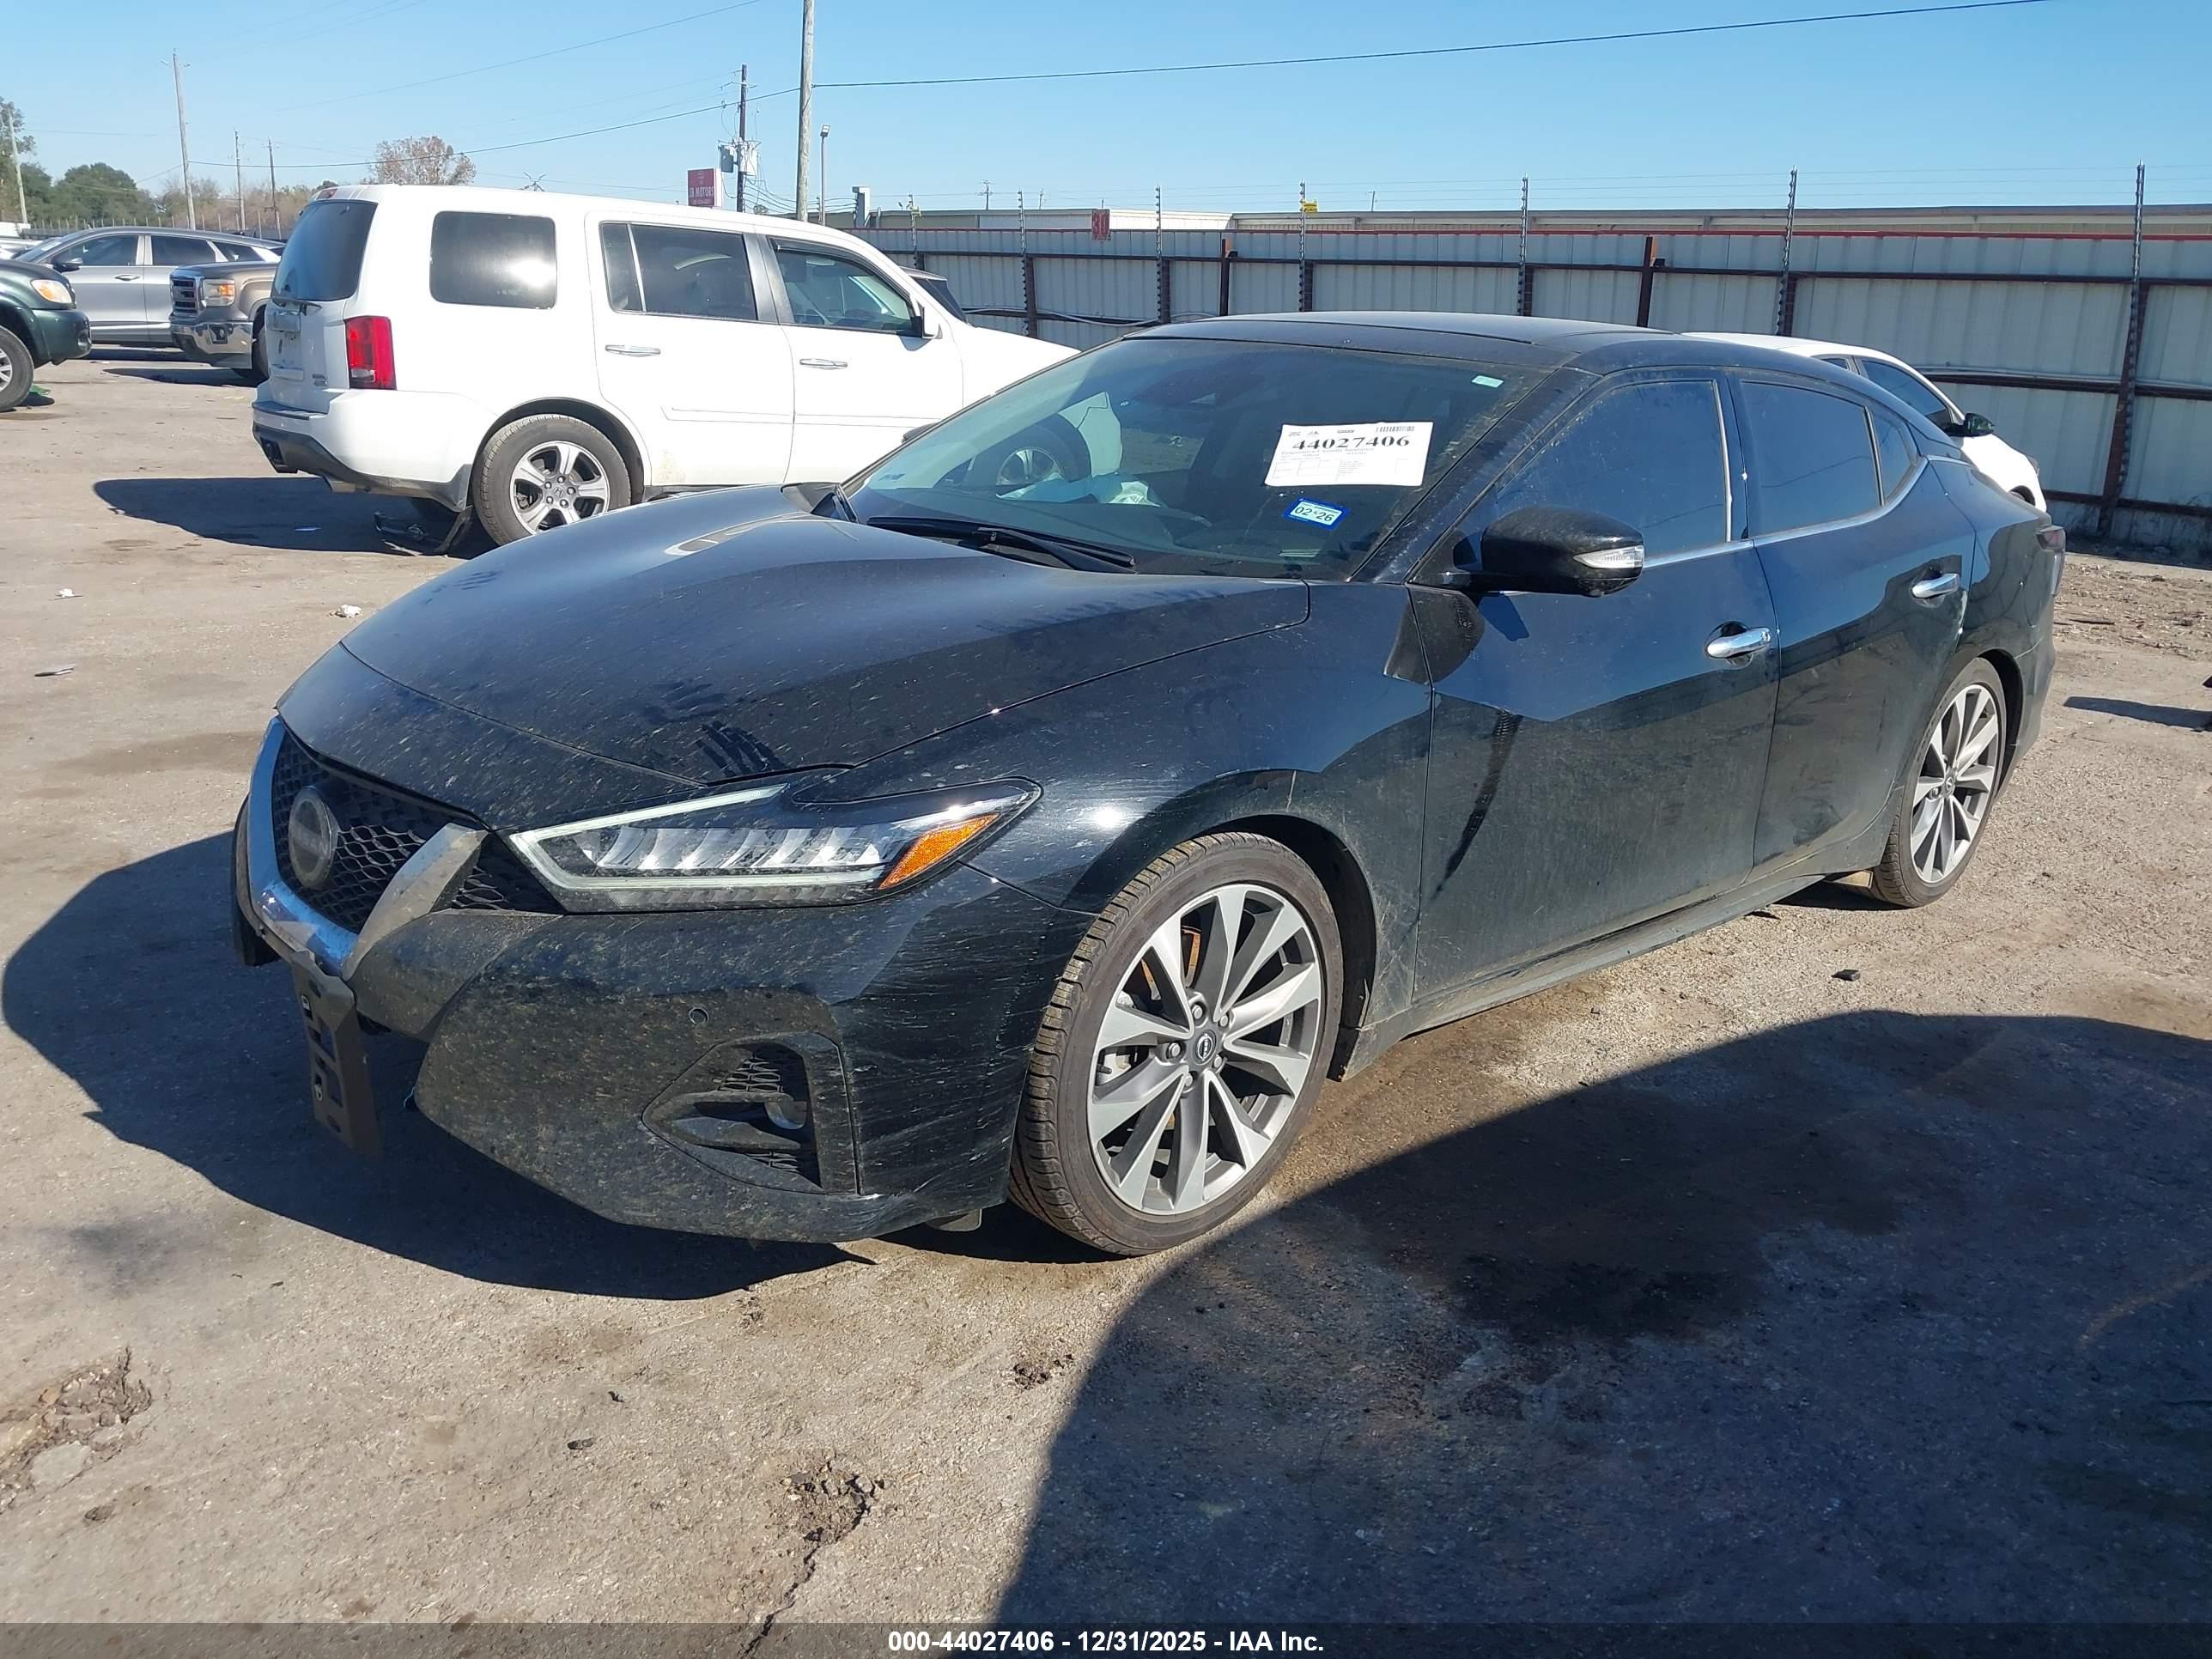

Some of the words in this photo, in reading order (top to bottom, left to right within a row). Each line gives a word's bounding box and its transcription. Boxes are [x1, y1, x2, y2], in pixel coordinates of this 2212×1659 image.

[1292, 435, 1410, 450] 44027406
[1295, 506, 1313, 517] 02
[1316, 512, 1335, 522] 26
